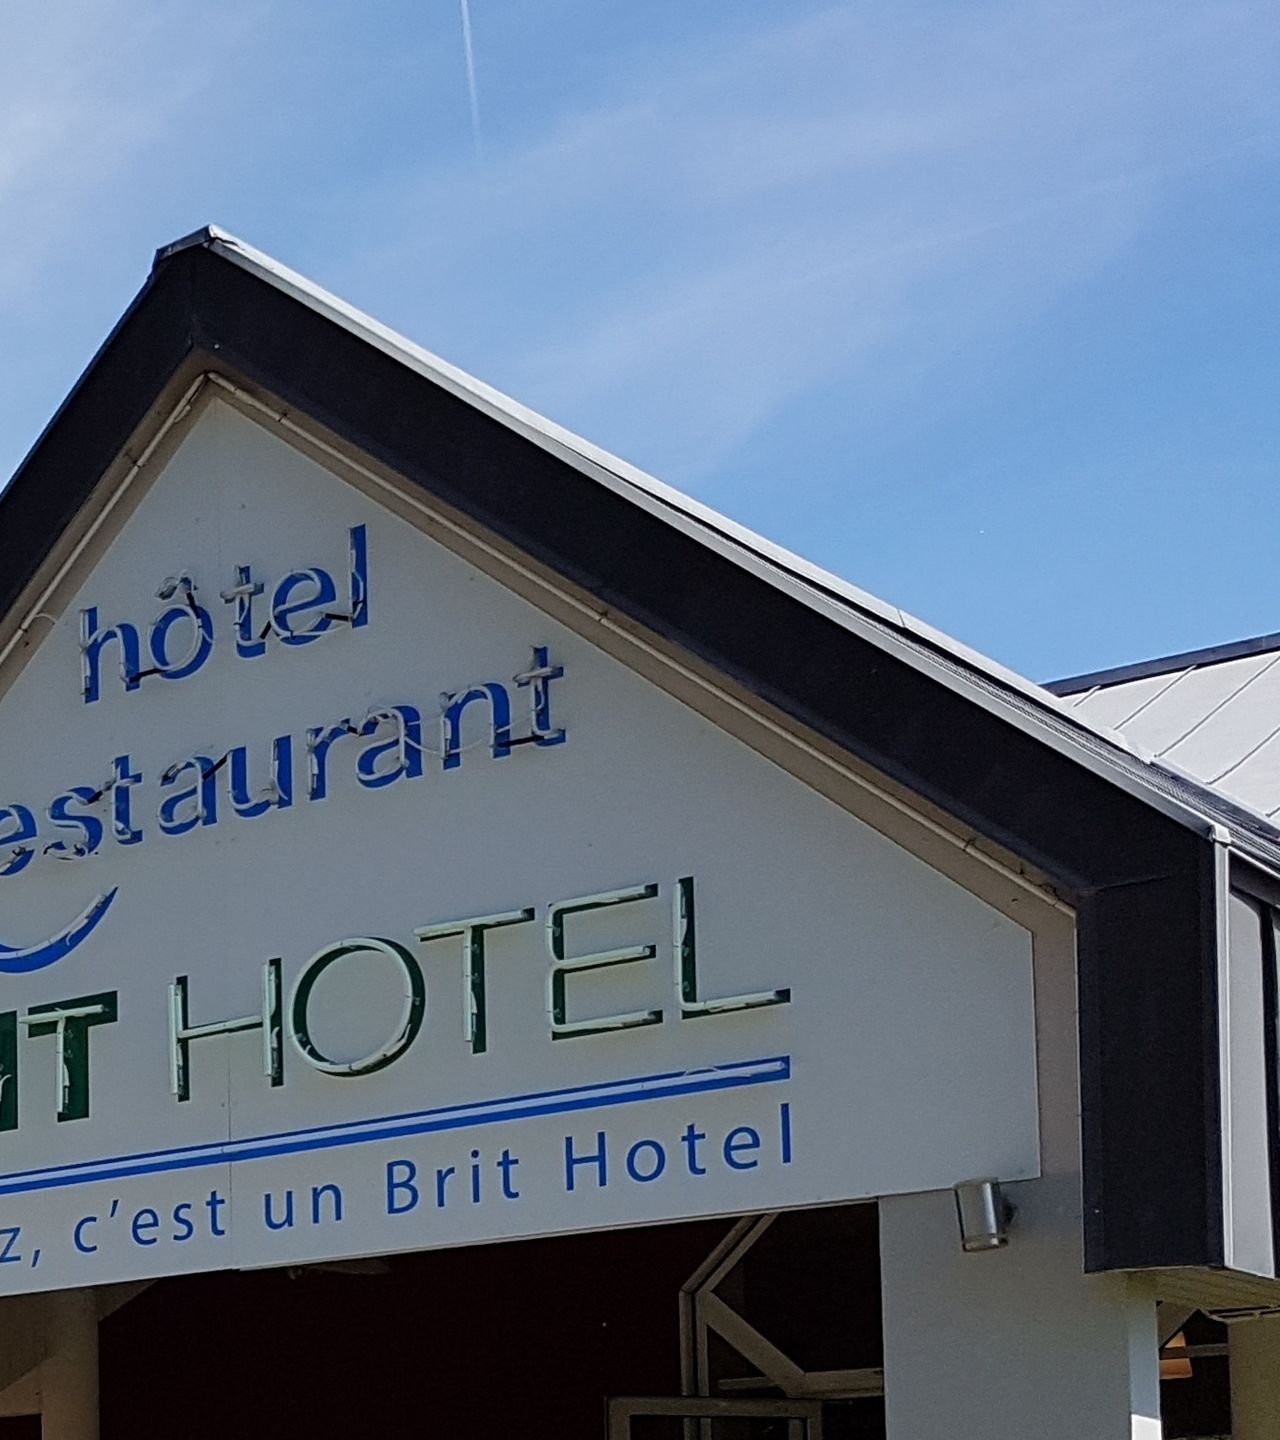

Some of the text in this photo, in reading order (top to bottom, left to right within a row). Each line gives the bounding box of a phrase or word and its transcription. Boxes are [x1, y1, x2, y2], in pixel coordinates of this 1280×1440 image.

[79, 524, 369, 704] hôtel
[169, 874, 792, 1102] HOTEL
[74, 1185, 226, 1255] c'est
[263, 1173, 344, 1231] un
[387, 1146, 519, 1217] Brit
[564, 1101, 792, 1192] Hotel
